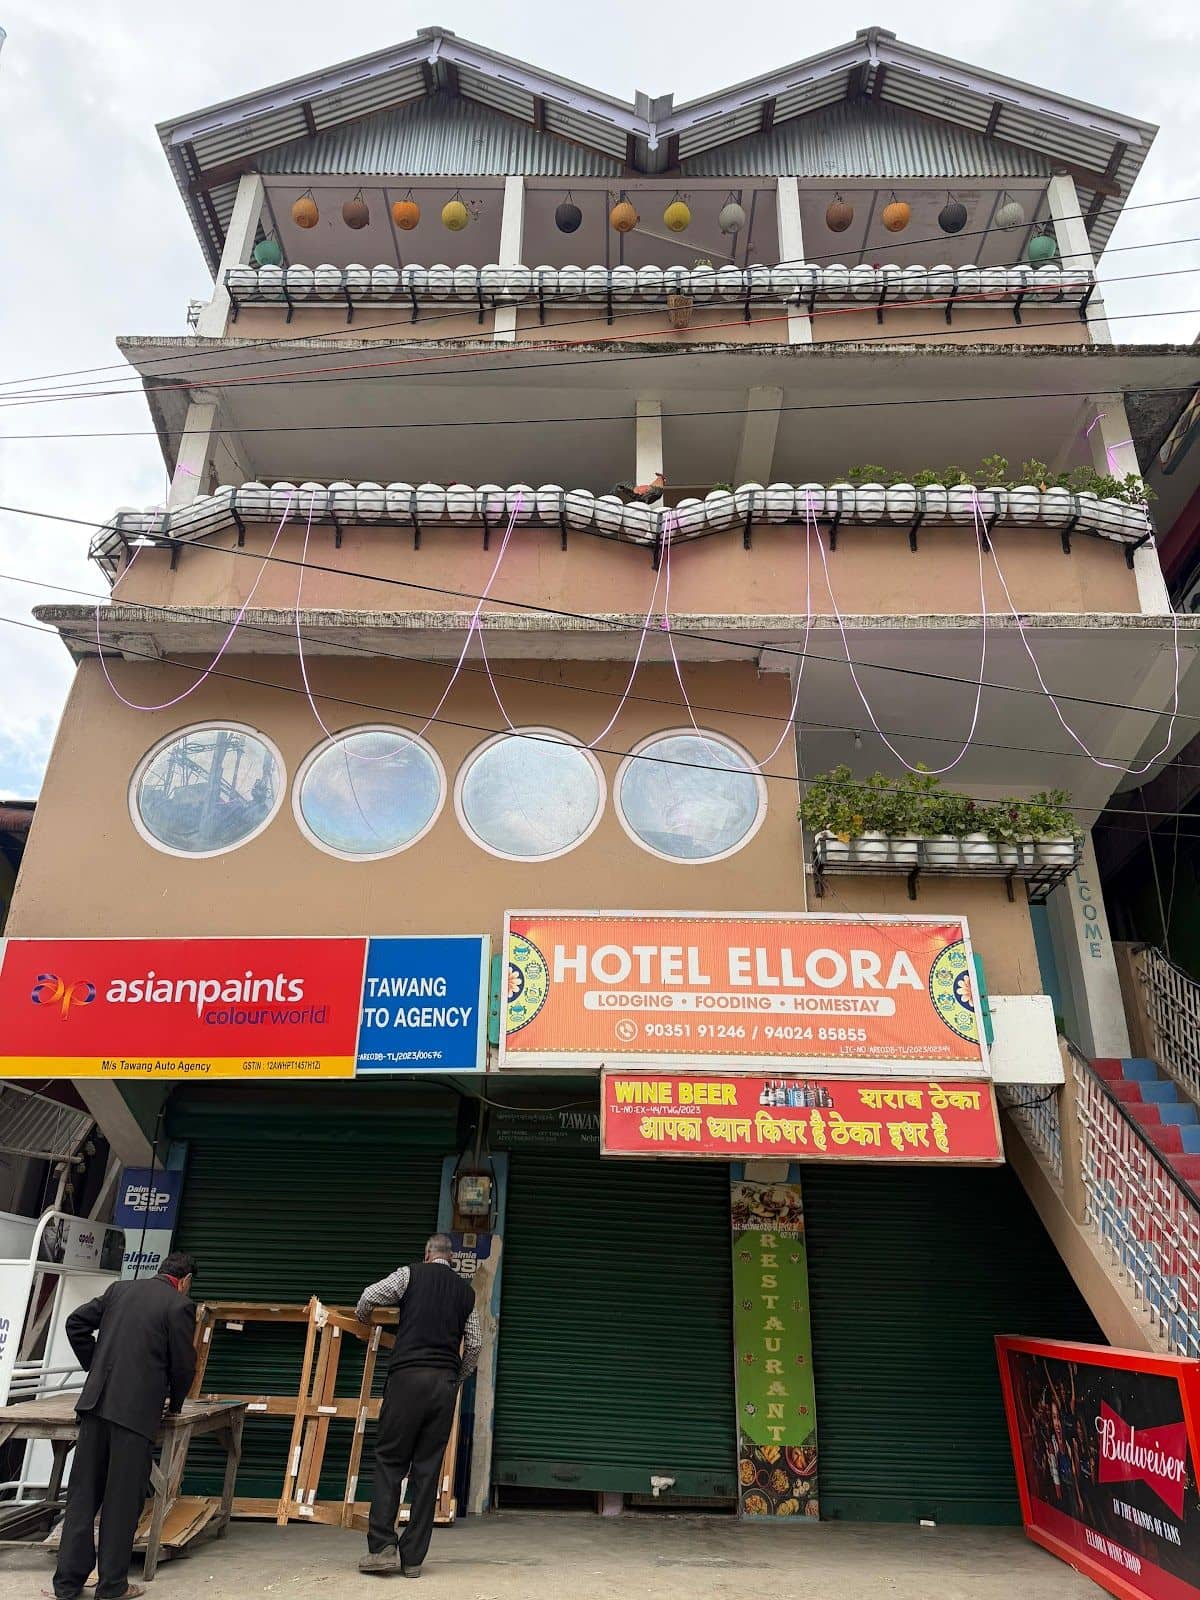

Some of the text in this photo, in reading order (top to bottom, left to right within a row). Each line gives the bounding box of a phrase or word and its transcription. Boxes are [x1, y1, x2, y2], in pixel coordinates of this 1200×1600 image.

[553, 944, 925, 991] HOTEL ELLORA
[106, 970, 304, 1018] asianpaints
[367, 977, 447, 997] TAWANG
[205, 1006, 327, 1025] colourworld
[597, 993, 880, 1013] LODGING FOODING HOMESTAY
[393, 1007, 471, 1028] AGENCY
[644, 1023, 692, 1037] 90351
[697, 1024, 746, 1039] 91246
[764, 1026, 813, 1041] 94024
[818, 1027, 867, 1042] 85855
[101, 1060, 117, 1073] M/s
[119, 1060, 153, 1073] Tawang
[155, 1059, 177, 1072] Auto
[178, 1059, 211, 1074] Agency
[243, 1061, 262, 1071] GSTIN
[614, 1081, 738, 1106] WINE BEER
[858, 1083, 981, 1111] शराब ठेका
[638, 1110, 951, 1153] आपका ध्यान किधर है ठेका इधर है
[125, 1193, 170, 1206] DSP
[760, 1233, 790, 1442] RESTAURANT
[1095, 1416, 1186, 1482] Budweiser
[1120, 1501, 1132, 1520] THE
[1132, 1506, 1154, 1532] HANDS
[1154, 1515, 1163, 1536] OF
[1163, 1521, 1181, 1545] FANS
[1085, 1529, 1141, 1575] ELLORA WINE SHOP
